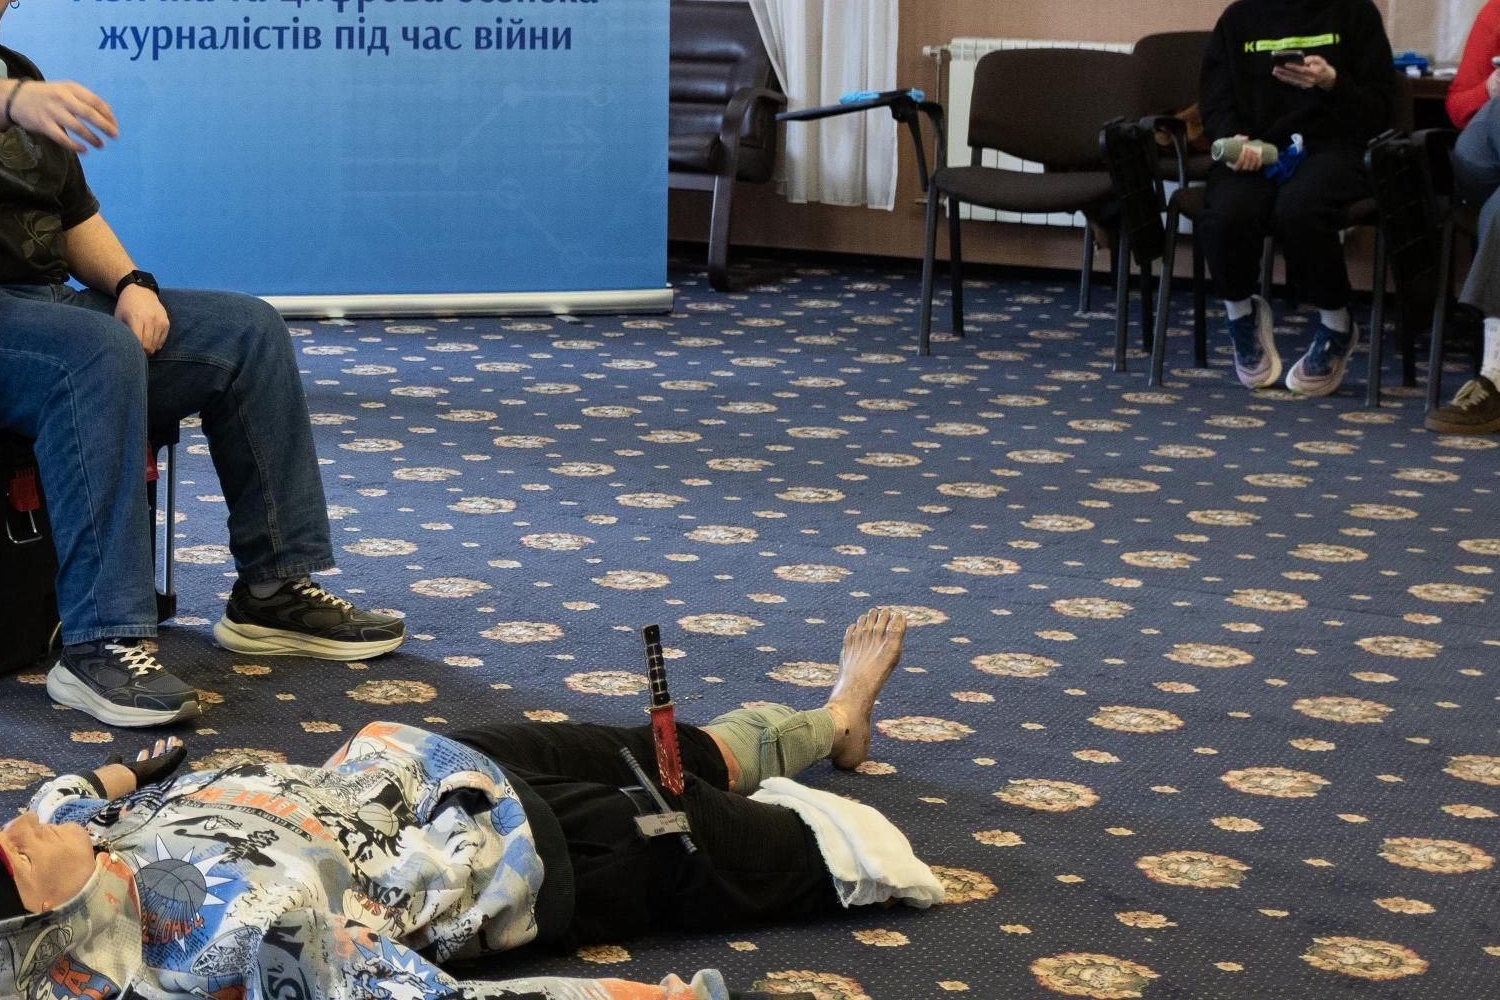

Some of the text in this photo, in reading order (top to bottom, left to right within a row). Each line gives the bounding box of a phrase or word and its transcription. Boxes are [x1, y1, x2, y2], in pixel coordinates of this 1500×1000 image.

[98, 16, 573, 62] журналістів під час війни
